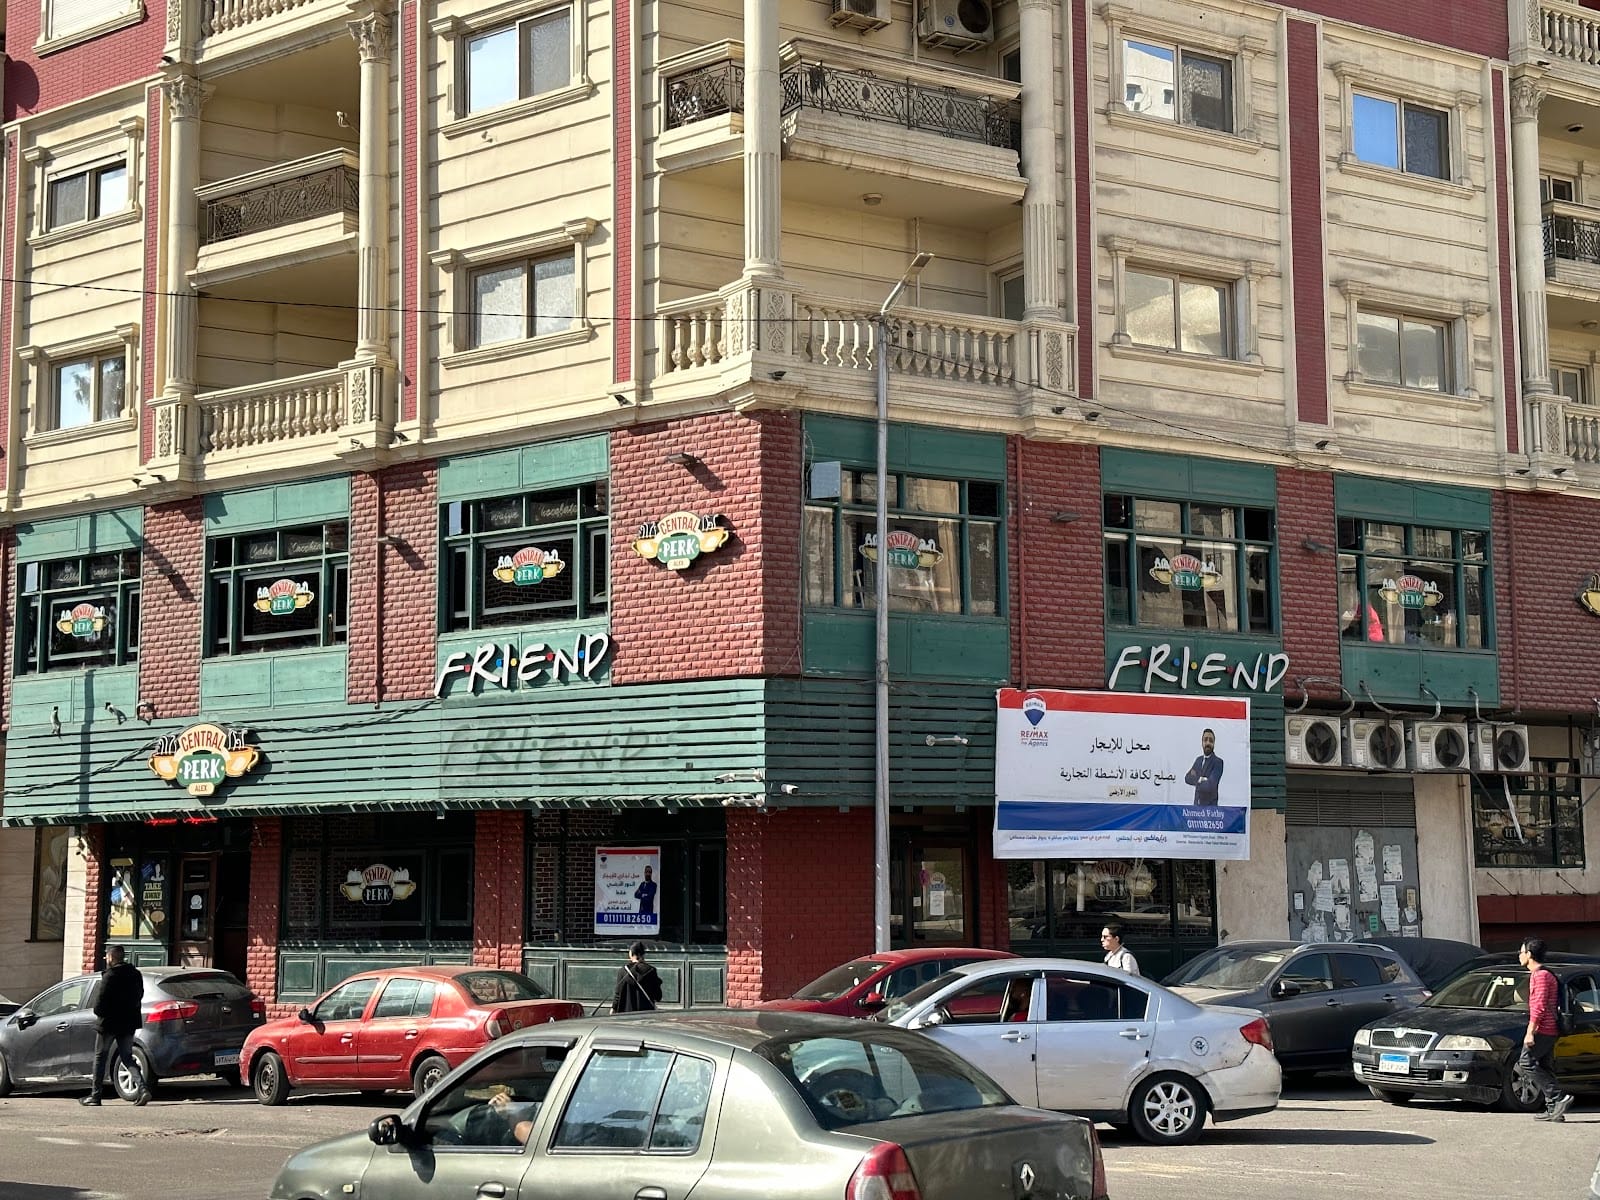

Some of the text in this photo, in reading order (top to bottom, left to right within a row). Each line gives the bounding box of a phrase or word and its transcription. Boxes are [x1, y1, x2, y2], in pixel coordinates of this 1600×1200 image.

[659, 516, 699, 535] CENTRAL
[662, 538, 696, 557] PERK
[886, 533, 917, 549] CENTRAL
[888, 552, 916, 566] PERK
[516, 568, 541, 581] PERK
[1175, 575, 1198, 587] PERK
[180, 730, 225, 752] CENTRAL
[1020, 730, 1049, 739] RE/MAX
[1125, 738, 1151, 754] محل
[182, 758, 222, 780] PERK
[1059, 765, 1177, 786] يصلح لكافة الأنشطة التجارية
[194, 784, 207, 792] ALEX
[1182, 808, 1226, 820] Ahmed Fathy
[364, 866, 392, 884] CENTRAL
[366, 887, 391, 901] PERK
[604, 914, 651, 923] 01111182650
